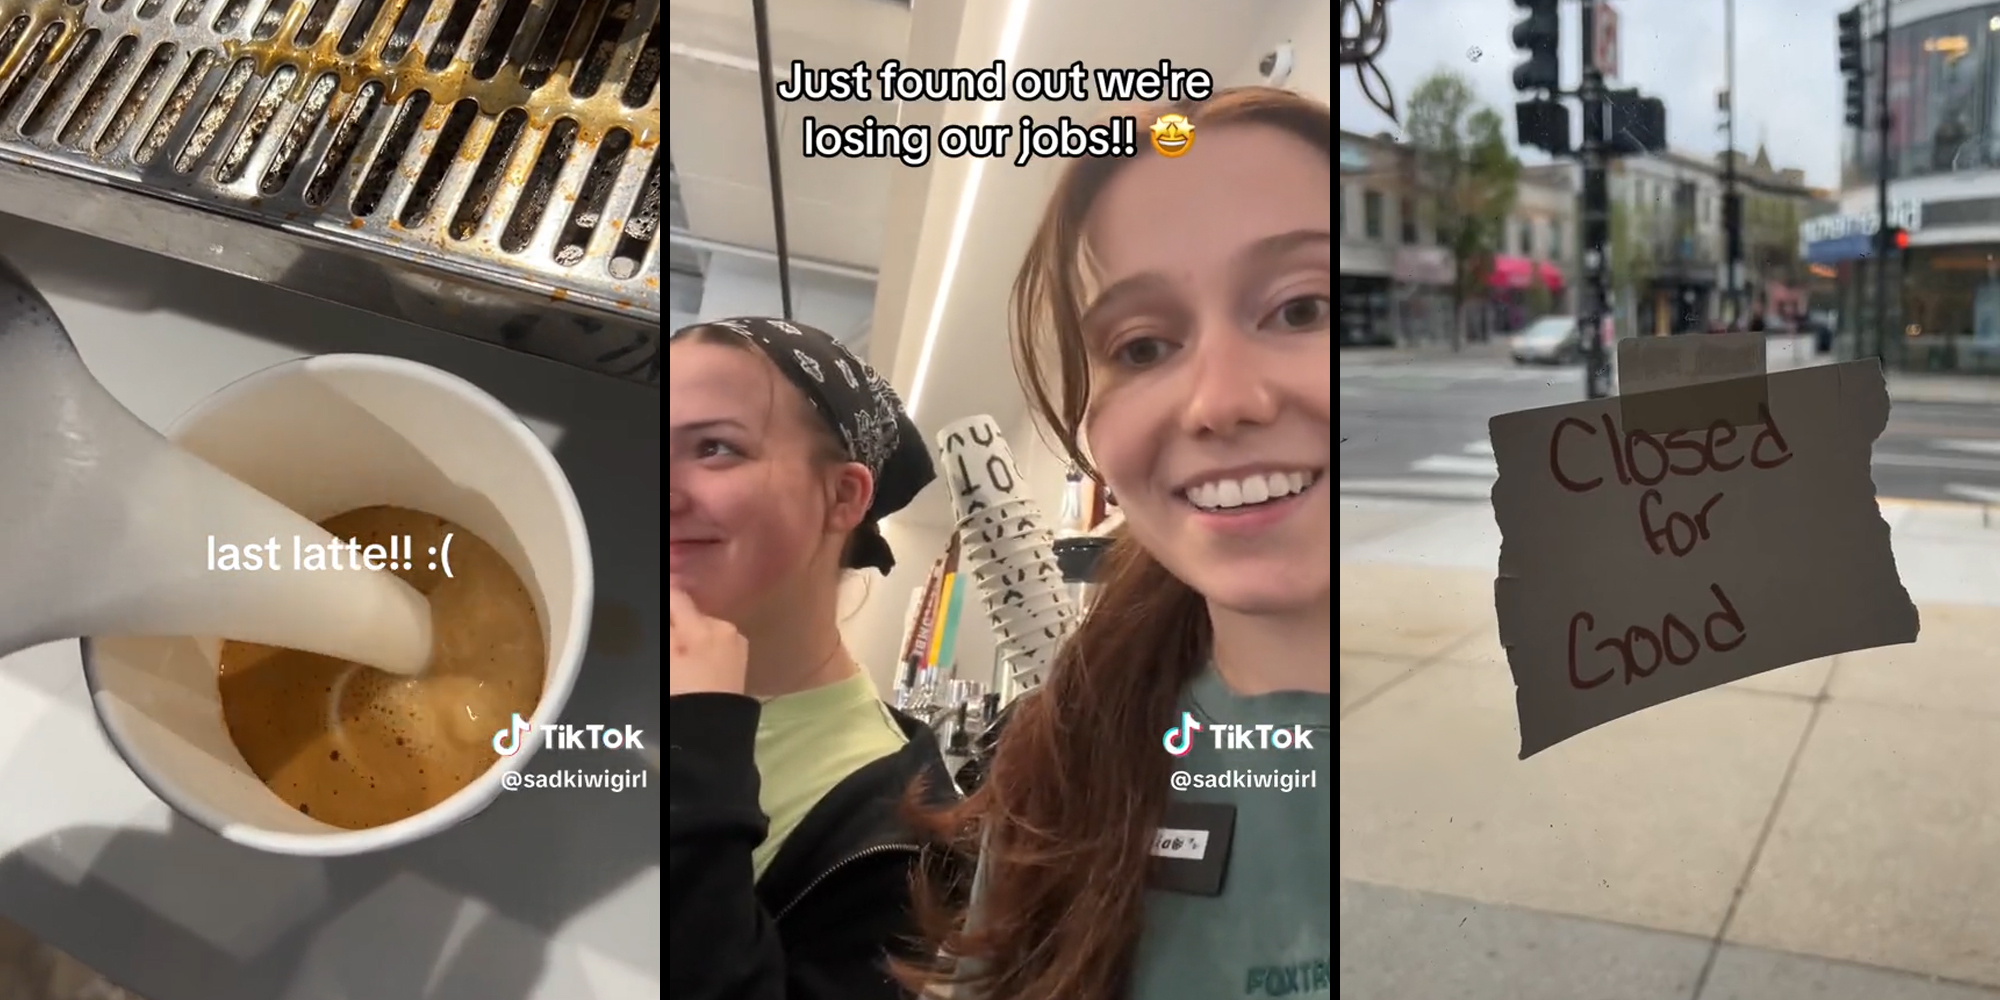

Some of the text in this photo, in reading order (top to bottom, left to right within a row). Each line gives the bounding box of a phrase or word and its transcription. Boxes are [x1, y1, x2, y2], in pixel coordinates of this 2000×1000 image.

[1550, 403, 1793, 492] Closed
[1640, 489, 1724, 557] for
[1568, 583, 1747, 690] Good
